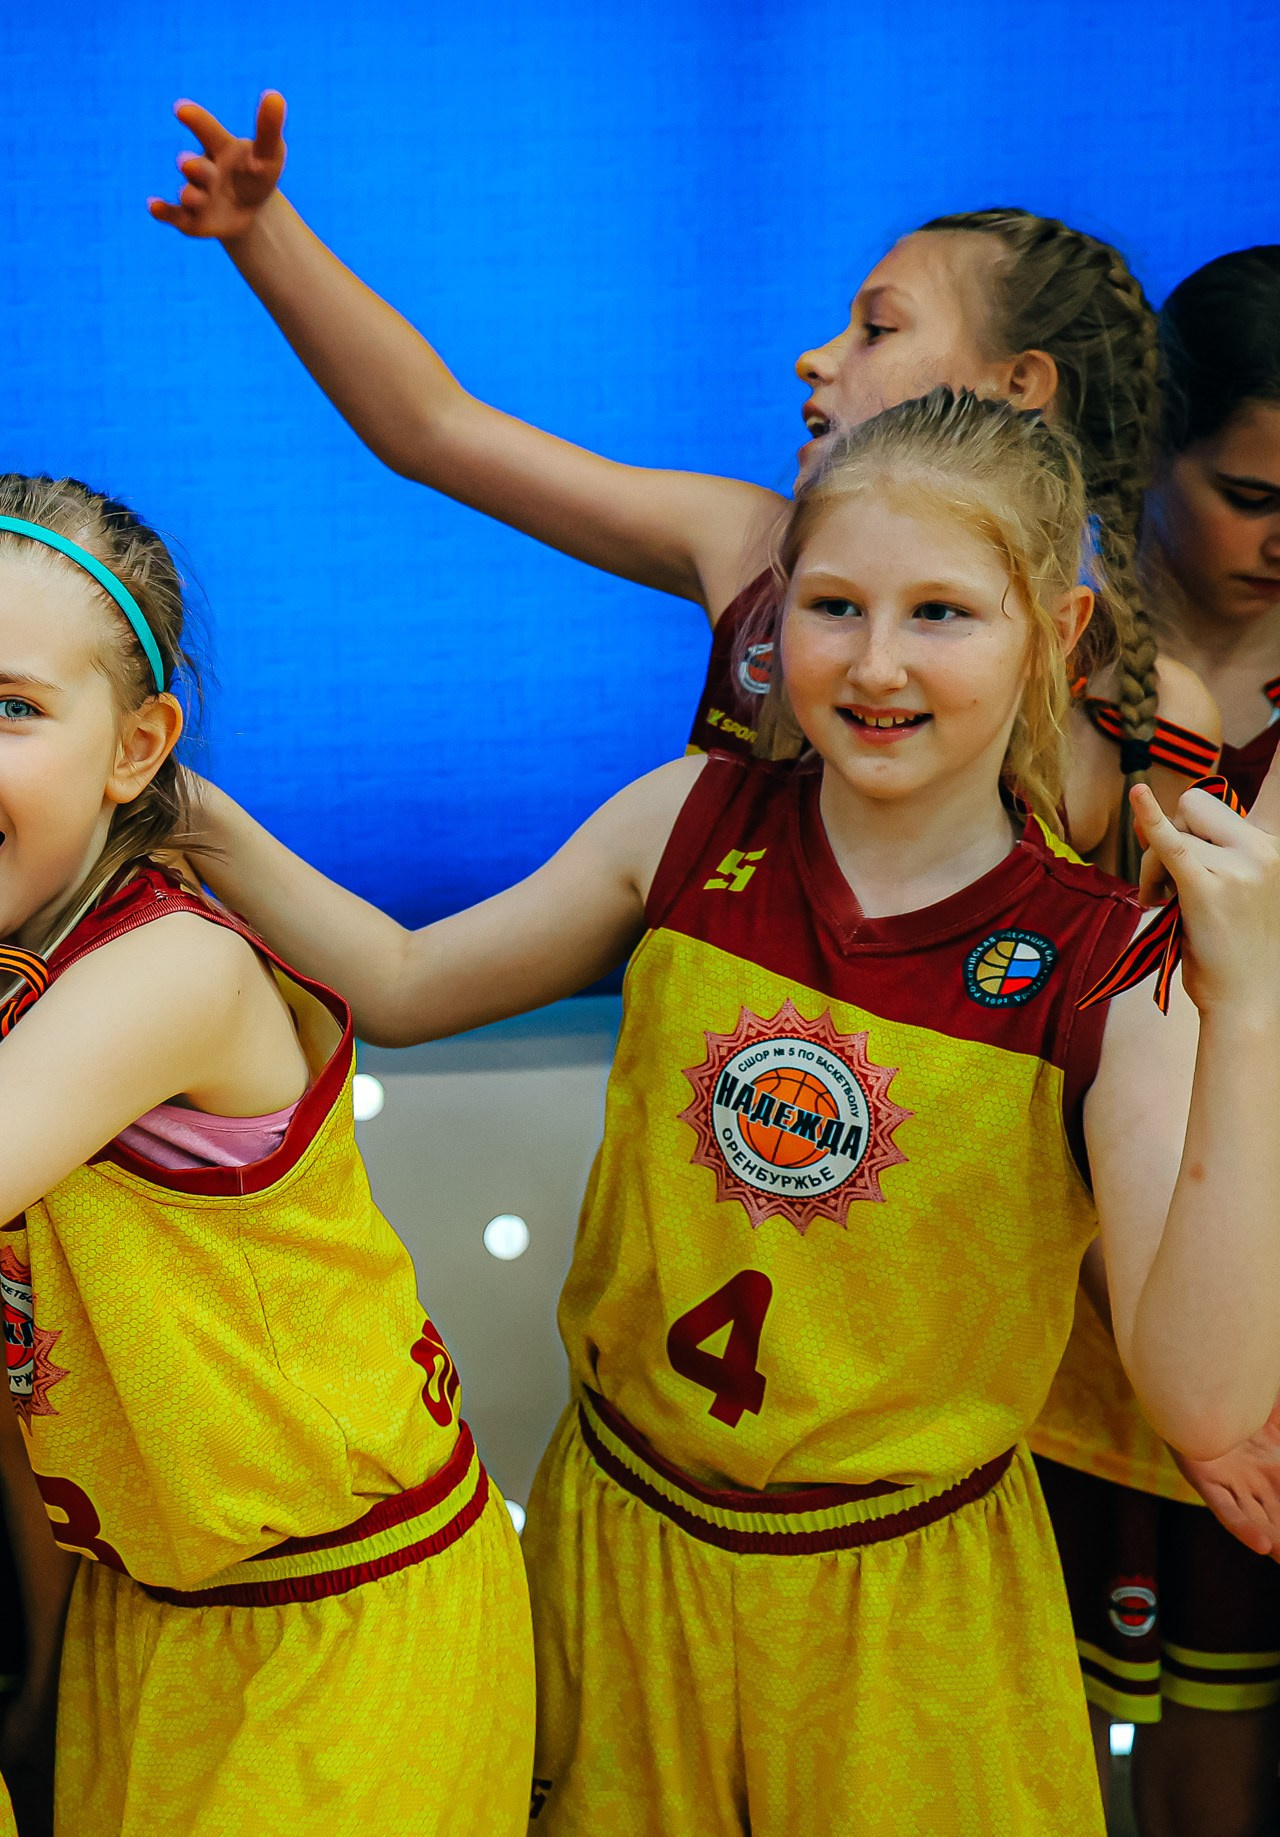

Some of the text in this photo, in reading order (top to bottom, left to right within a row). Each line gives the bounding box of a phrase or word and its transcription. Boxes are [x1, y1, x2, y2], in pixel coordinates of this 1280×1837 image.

[716, 1071, 864, 1161] НАДЕЖДА
[738, 1050, 770, 1073] СШОР
[788, 1047, 795, 1056] 5
[798, 1049, 816, 1061] ПО
[816, 1056, 860, 1118] БАСКЕТБОЛУ
[722, 1127, 835, 1190] ОРЕНБУРЖЬЕ
[667, 1269, 773, 1429] 4
